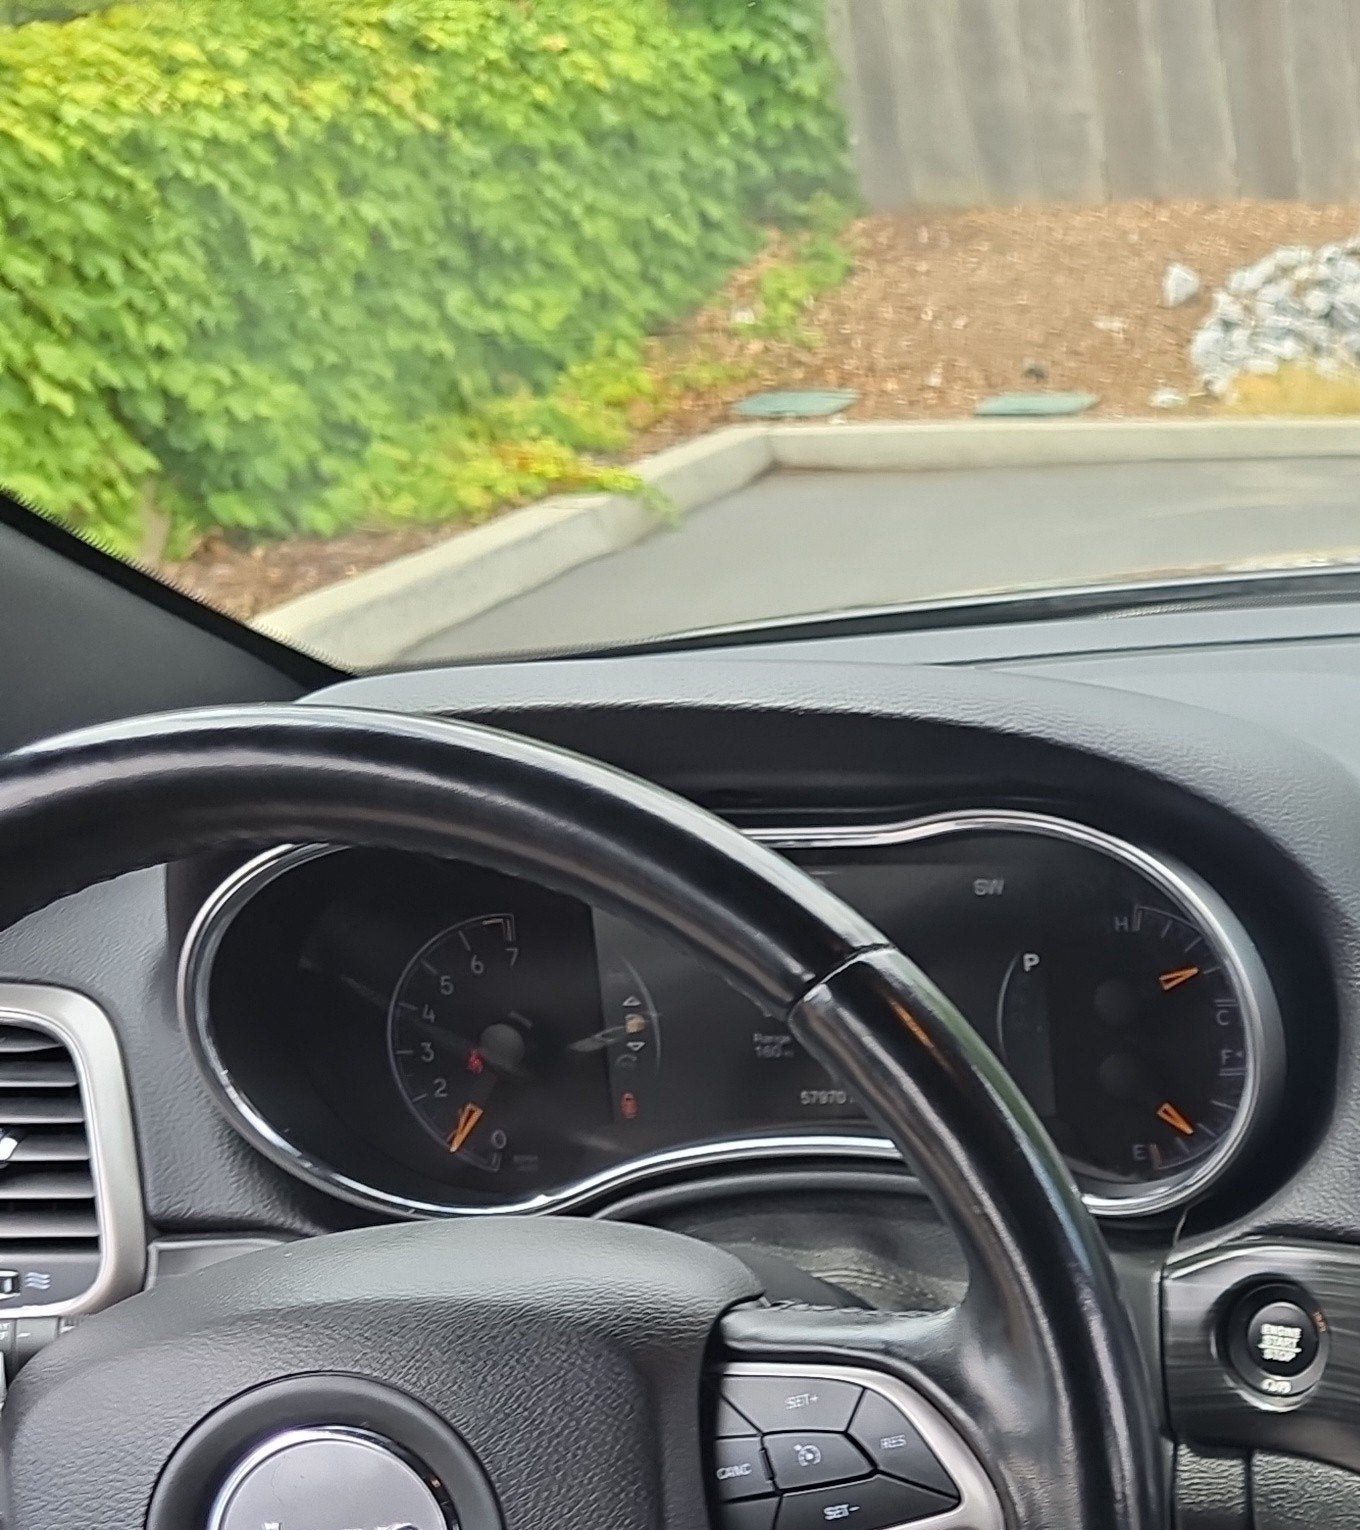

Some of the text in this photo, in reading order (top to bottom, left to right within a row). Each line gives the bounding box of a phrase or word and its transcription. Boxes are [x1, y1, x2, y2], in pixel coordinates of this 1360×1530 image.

[973, 878, 1004, 896] SW
[1115, 916, 1129, 932] H
[470, 954, 484, 975] 6
[505, 947, 519, 966] 7
[1022, 952, 1040, 972] P
[439, 975, 454, 996] 5
[422, 1004, 436, 1023] 4
[1215, 1010, 1230, 1026] C
[420, 1041, 435, 1063] 3
[1221, 1050, 1234, 1064] F
[433, 1078, 448, 1098] 2
[490, 1129, 507, 1149] 0
[1133, 1144, 1147, 1161] E
[880, 1434, 907, 1449] RES
